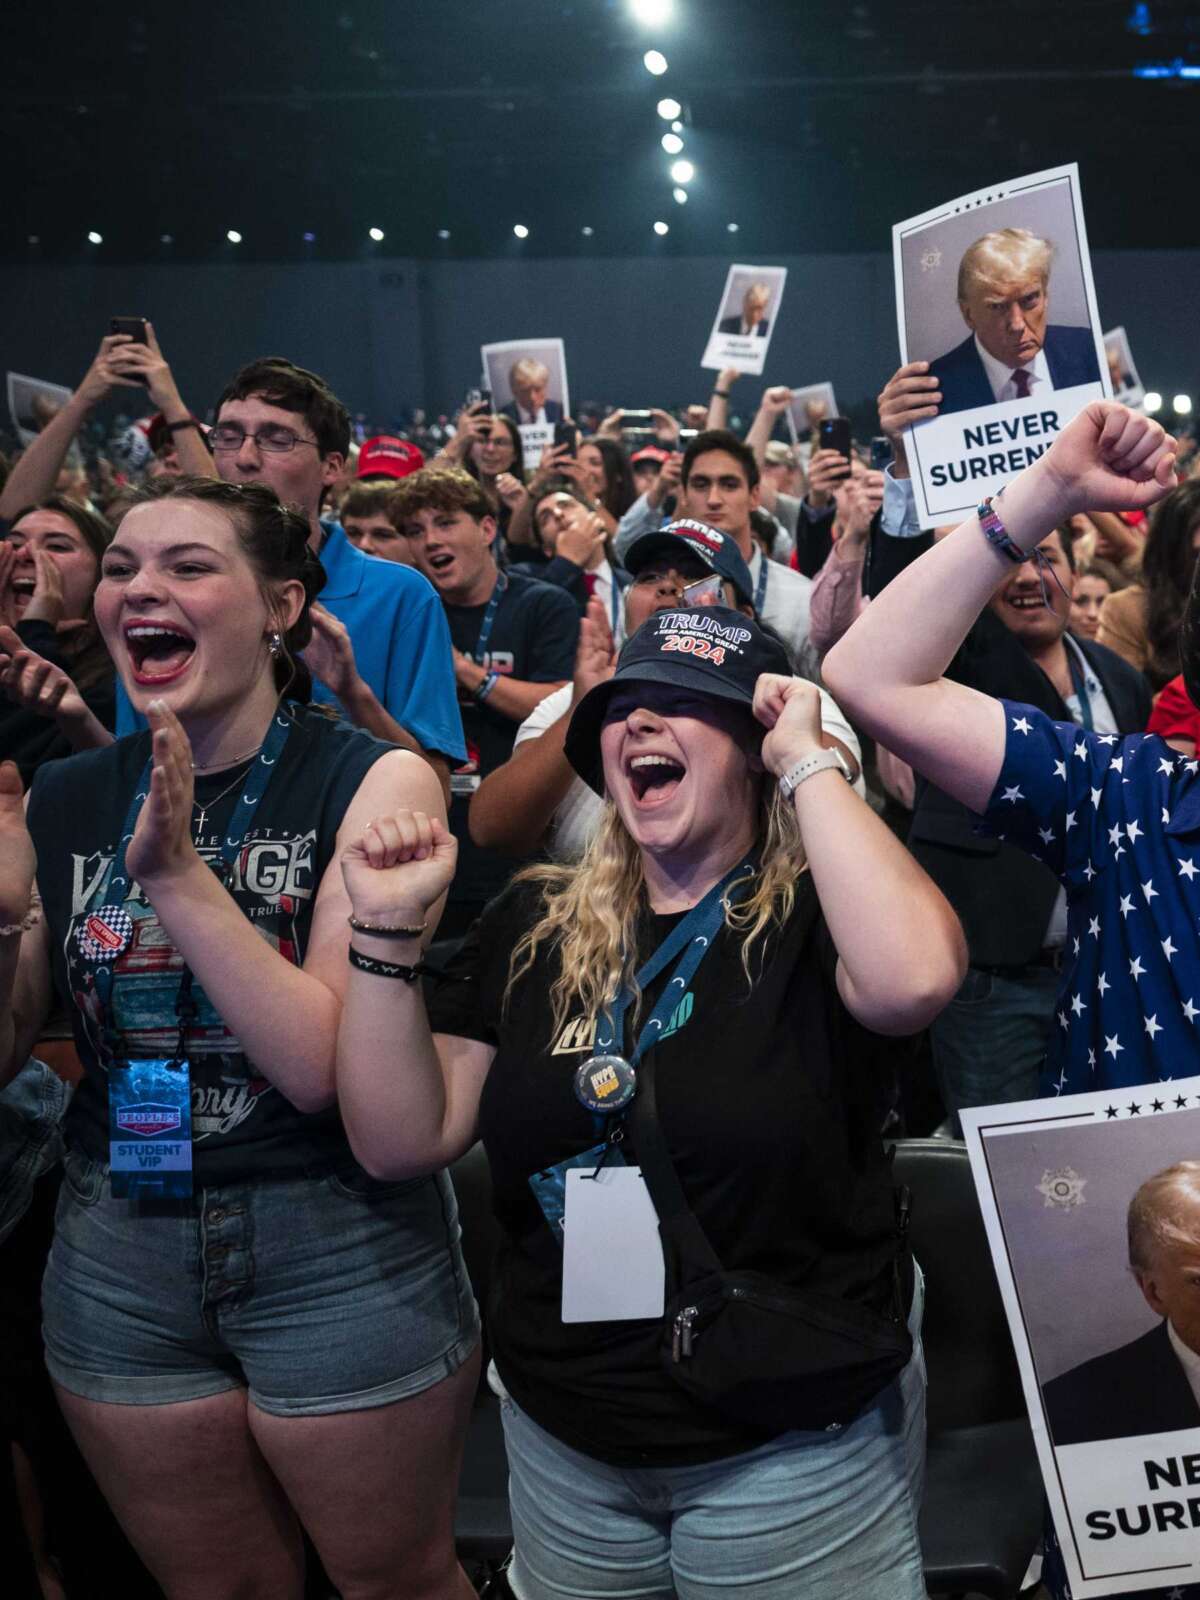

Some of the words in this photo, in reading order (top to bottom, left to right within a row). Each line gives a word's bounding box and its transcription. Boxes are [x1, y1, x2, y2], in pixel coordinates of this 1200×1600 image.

[963, 410, 1061, 450] NEVER
[929, 441, 1054, 487] SURREN
[658, 613, 752, 645] TRUMP
[678, 629, 714, 642] AMERICA
[714, 638, 739, 651] GREAT
[660, 634, 726, 667] 2024
[247, 903, 283, 918] TRUE
[118, 1112, 180, 1123] PEOPLE'S
[118, 1145, 182, 1157] STUDENT
